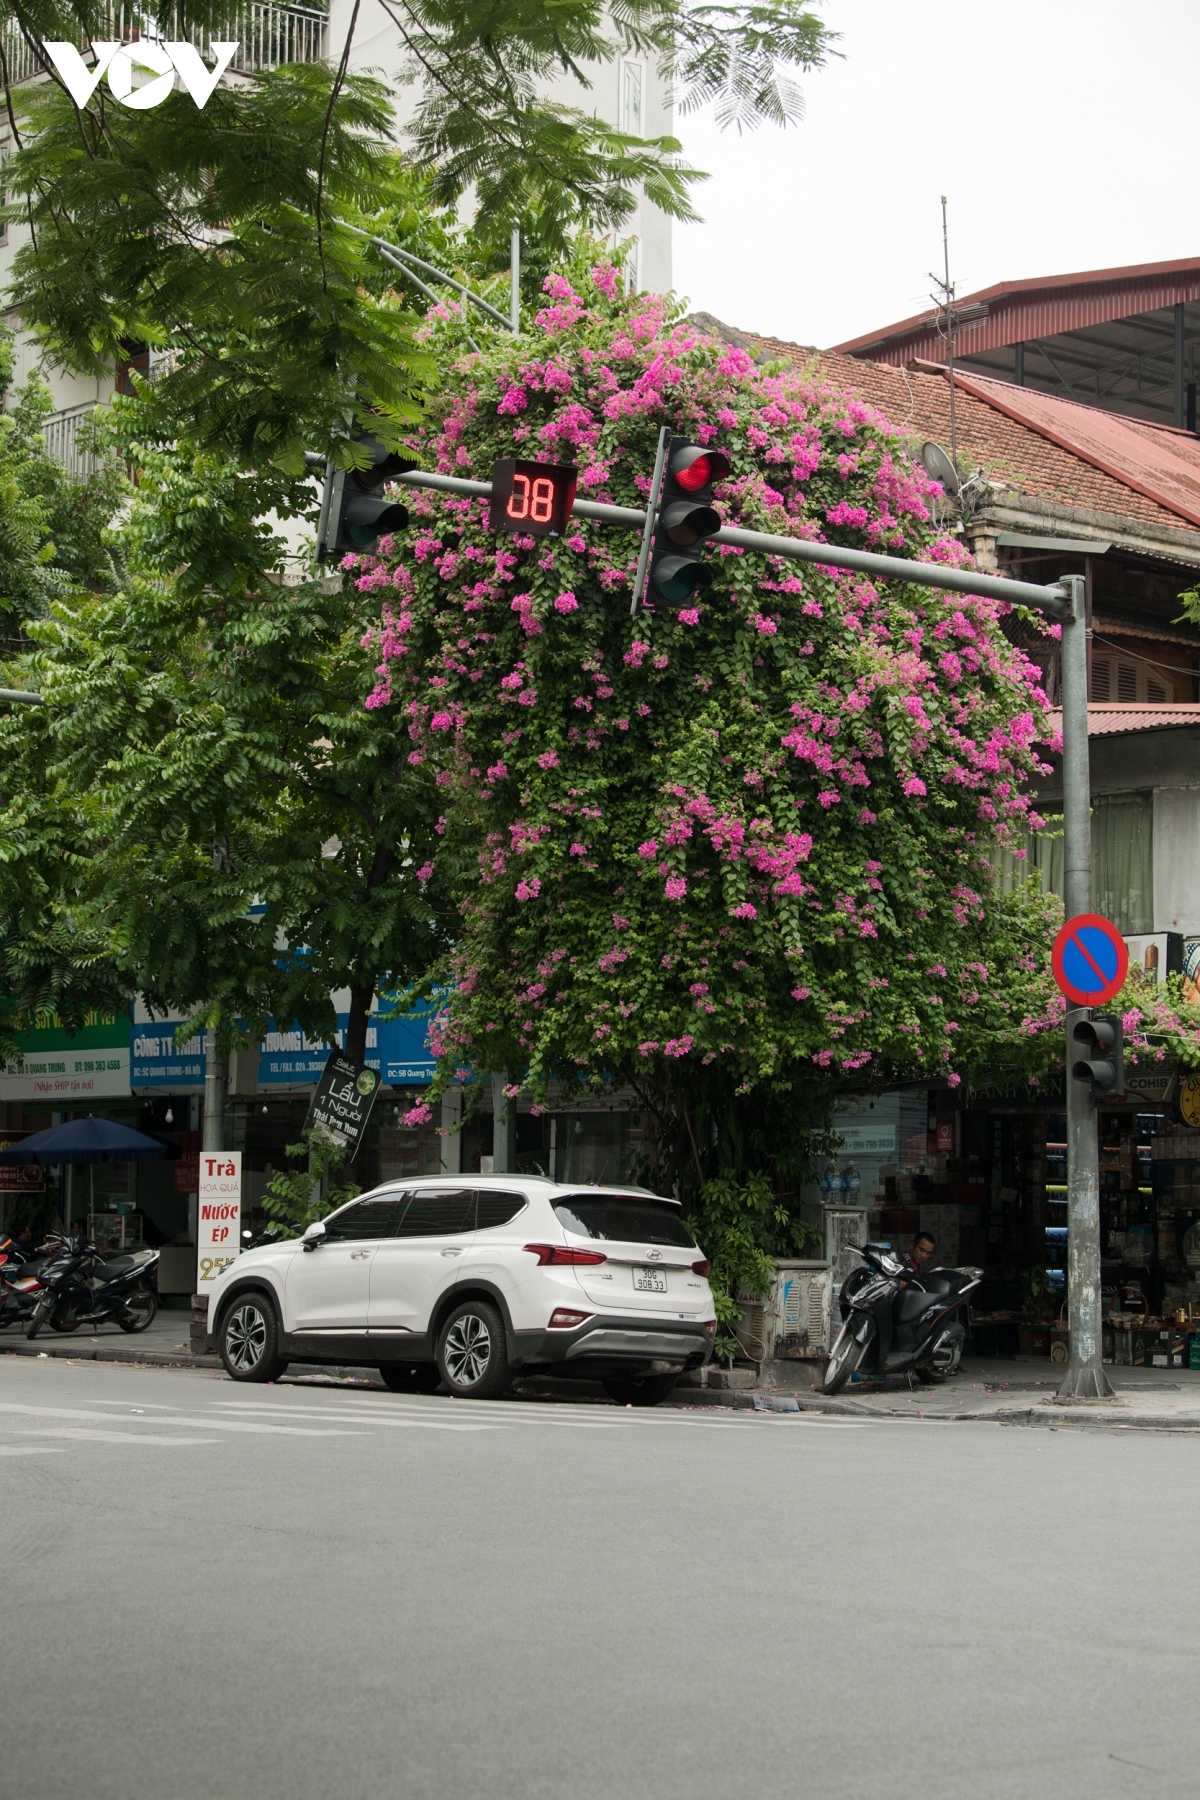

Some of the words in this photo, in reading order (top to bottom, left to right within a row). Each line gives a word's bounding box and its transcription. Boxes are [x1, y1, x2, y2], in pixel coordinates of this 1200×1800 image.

[133, 1034, 160, 1058] CÔNG
[161, 1037, 173, 1057] TY
[29, 1064, 47, 1075] QUANG
[48, 1062, 65, 1073] TRUNG
[407, 1069, 425, 1079] Quang
[425, 1069, 438, 1077] Tru
[1129, 1078, 1168, 1090] COHIB
[328, 1078, 362, 1107] Lẩu
[205, 1159, 236, 1177] Trà
[200, 1184, 217, 1192] HOA
[219, 1181, 239, 1192] QUẢ
[643, 1269, 657, 1280] 30G
[637, 1279, 664, 1290] 908.33
